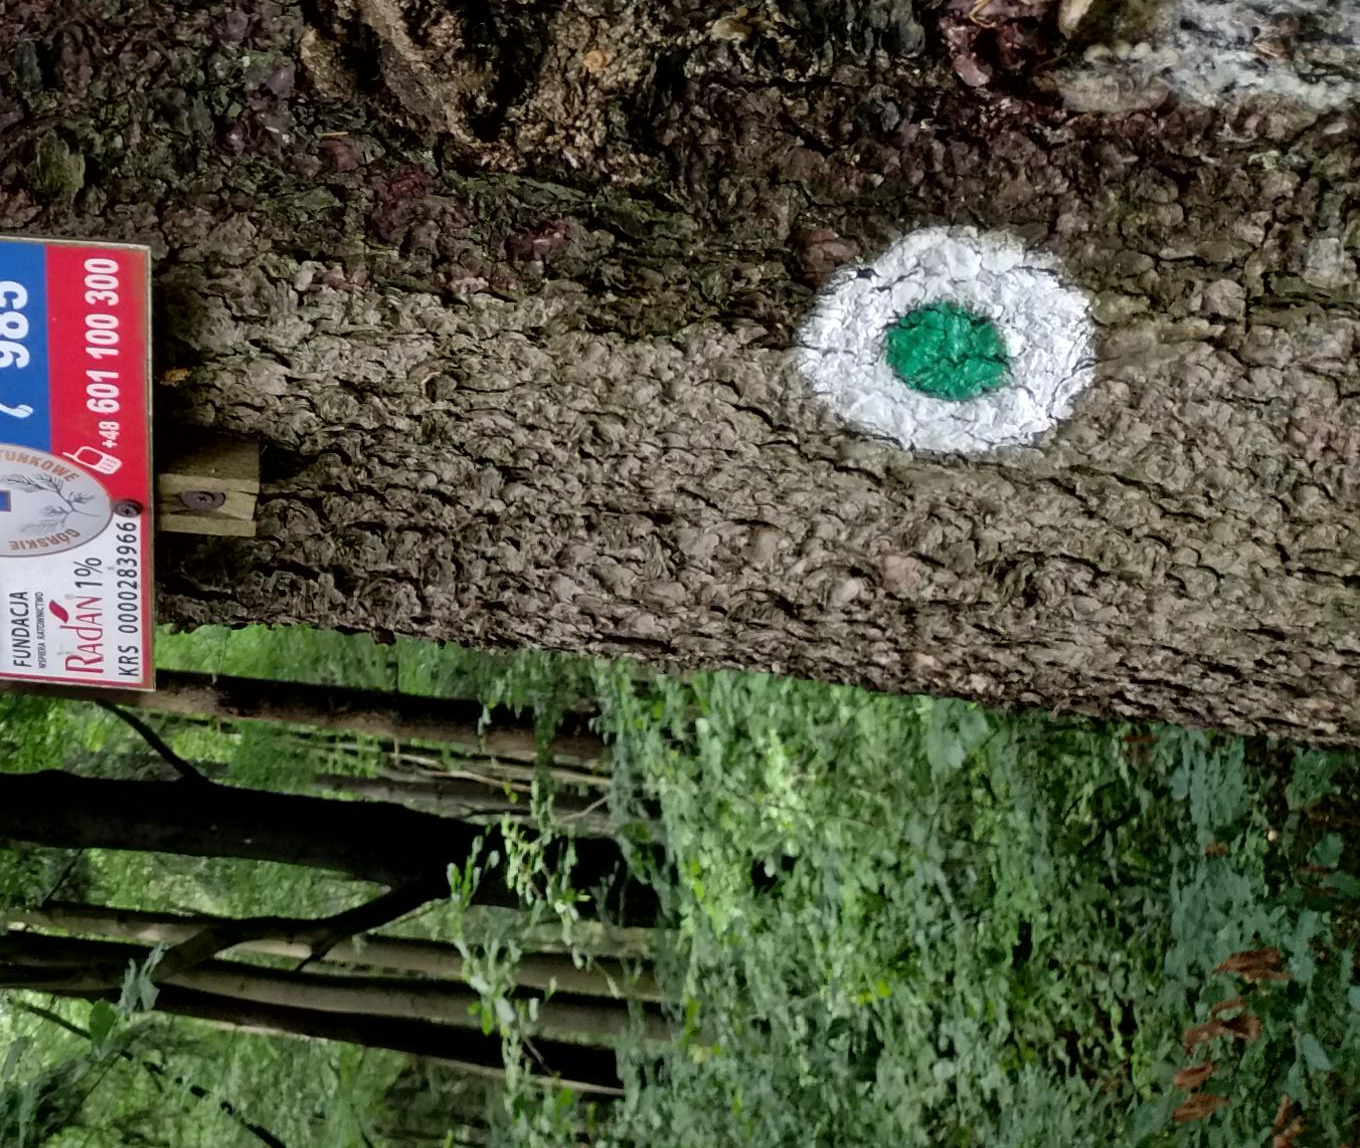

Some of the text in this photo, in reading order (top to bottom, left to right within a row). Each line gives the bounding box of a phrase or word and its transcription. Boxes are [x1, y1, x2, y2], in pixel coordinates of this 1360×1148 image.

[84, 258, 120, 448] +48 601 100 300
[9, 592, 31, 668] FUNDACJA
[73, 557, 103, 588] 1%
[116, 521, 140, 677] KRS 0000283966
